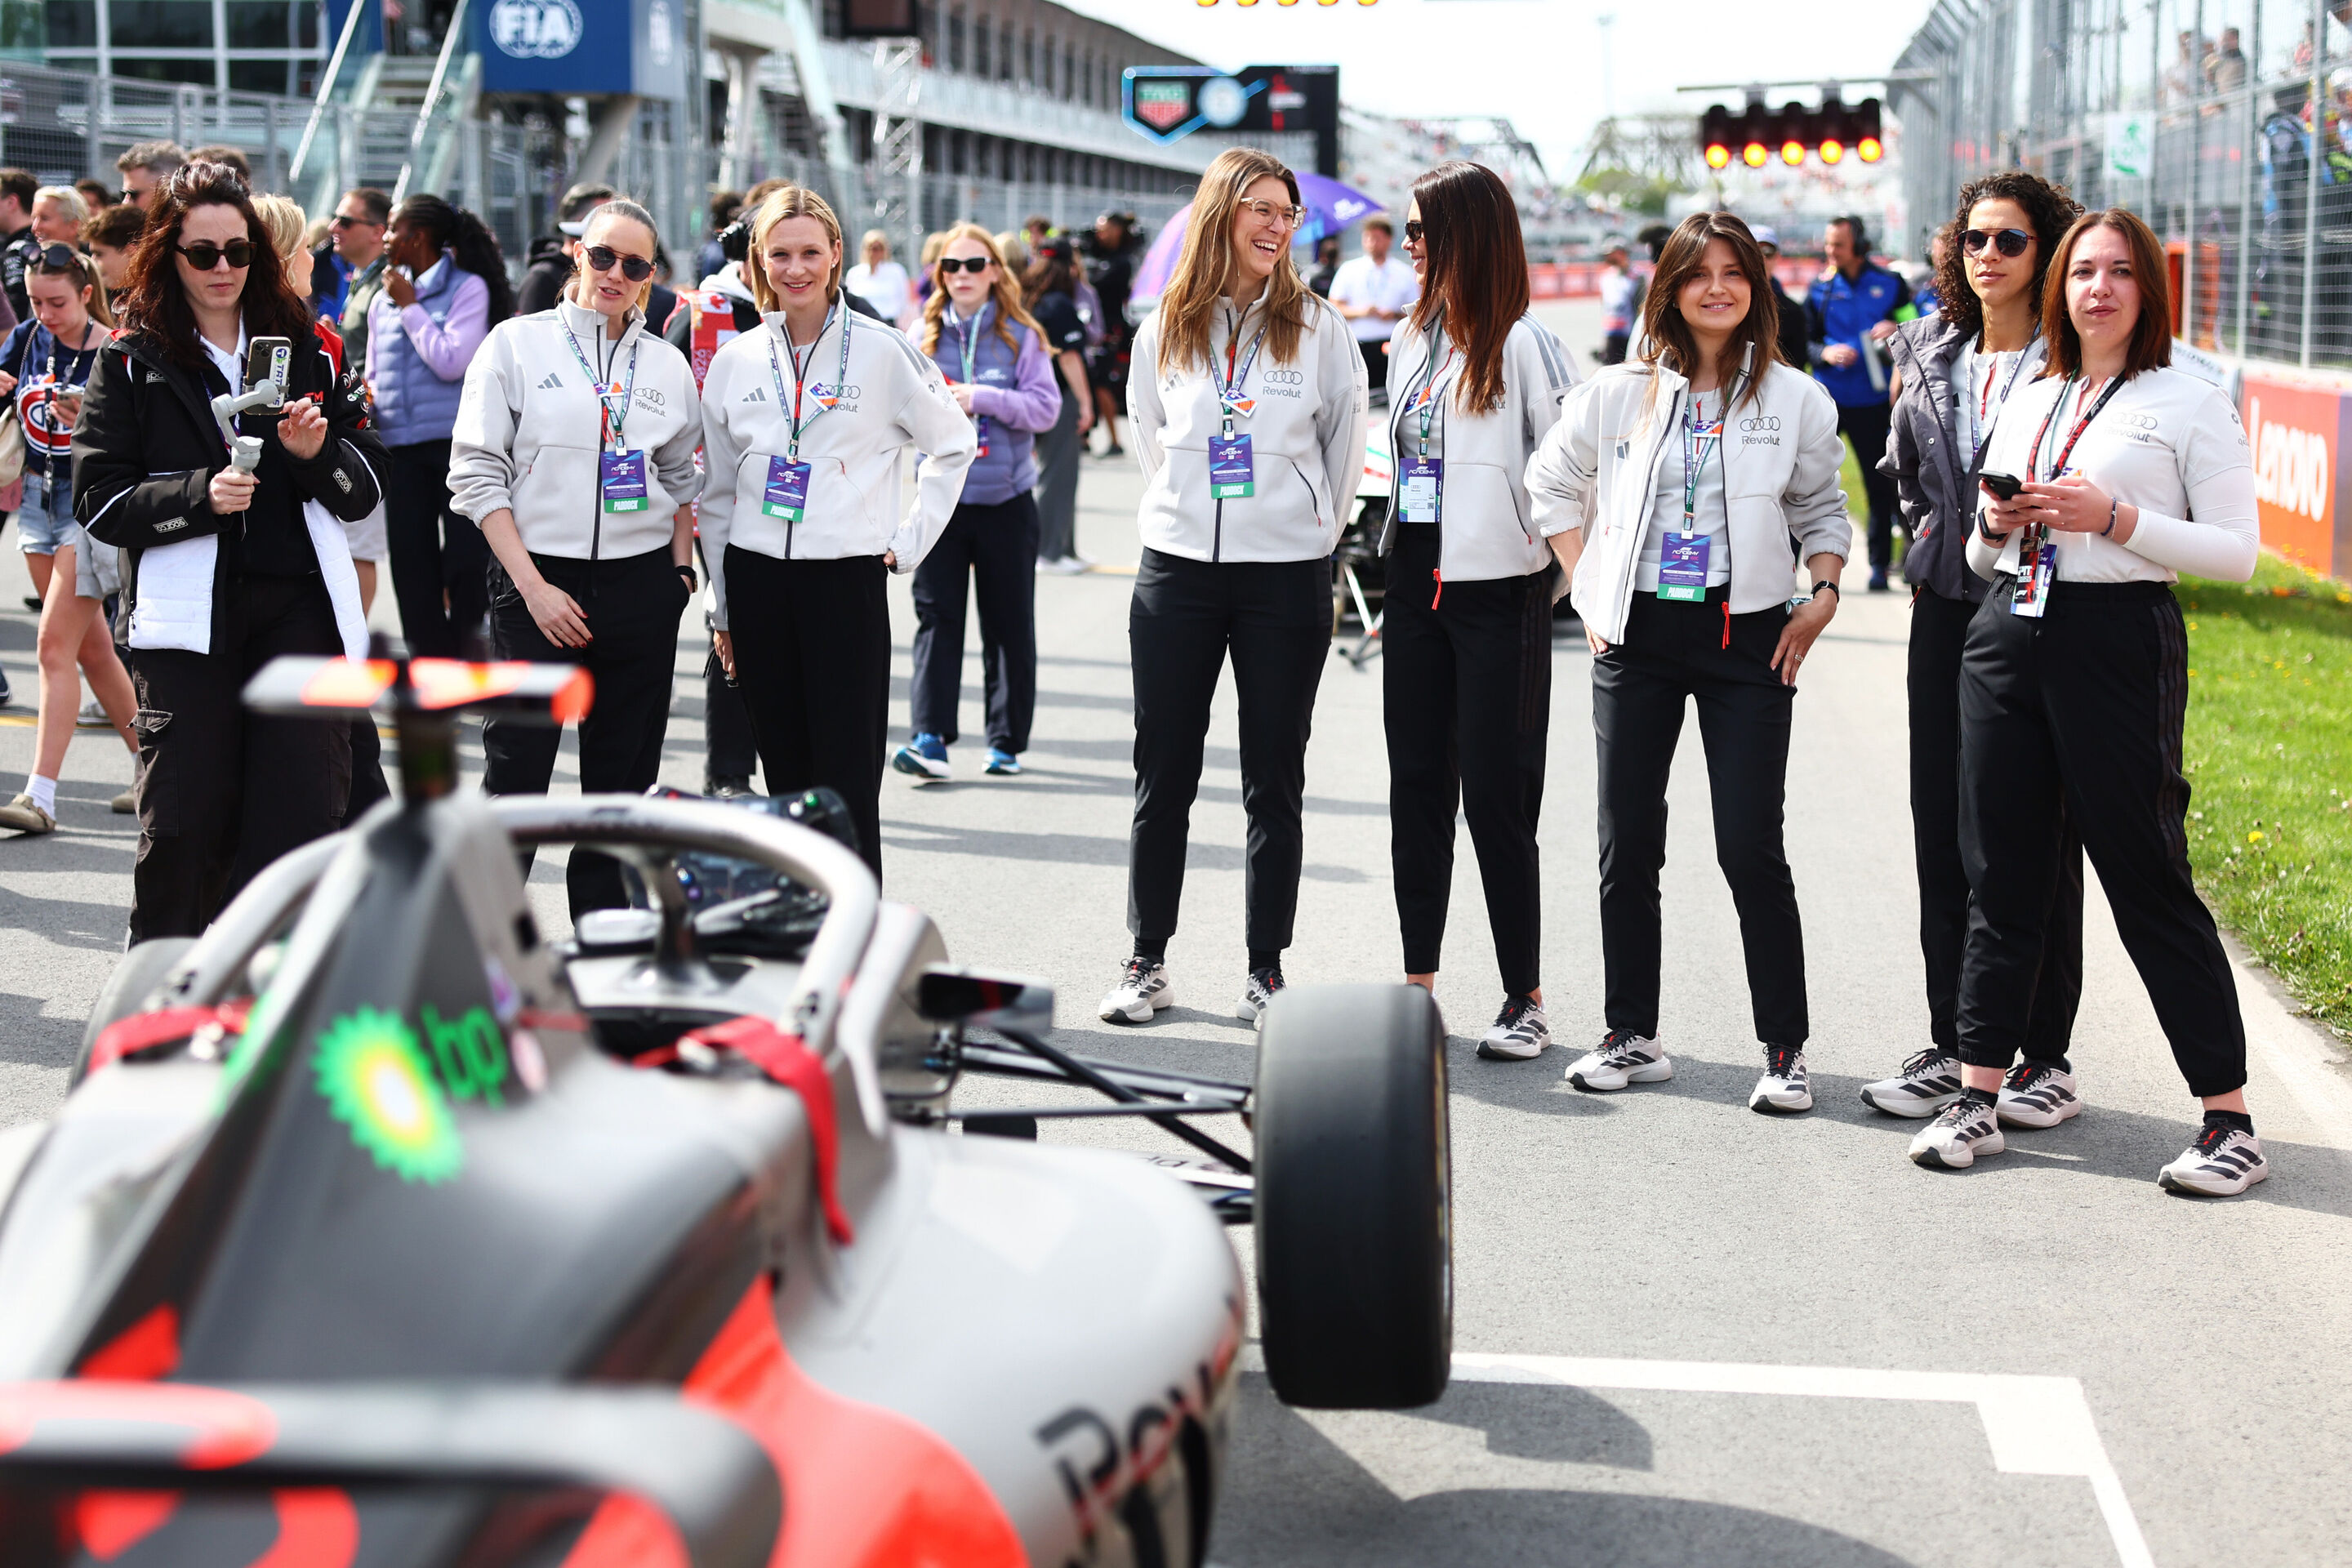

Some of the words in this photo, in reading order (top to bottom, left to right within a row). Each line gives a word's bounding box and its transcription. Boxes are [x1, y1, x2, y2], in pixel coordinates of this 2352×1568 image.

[496, 4, 573, 45] FIA
[272, 364, 284, 406] TATS
[1263, 386, 1302, 399] Revolut
[635, 399, 666, 417] Revolut
[832, 403, 858, 412] volut
[1742, 435, 1780, 446] Revolut
[2250, 396, 2328, 522] Lenovo
[420, 1001, 507, 1108] bp
